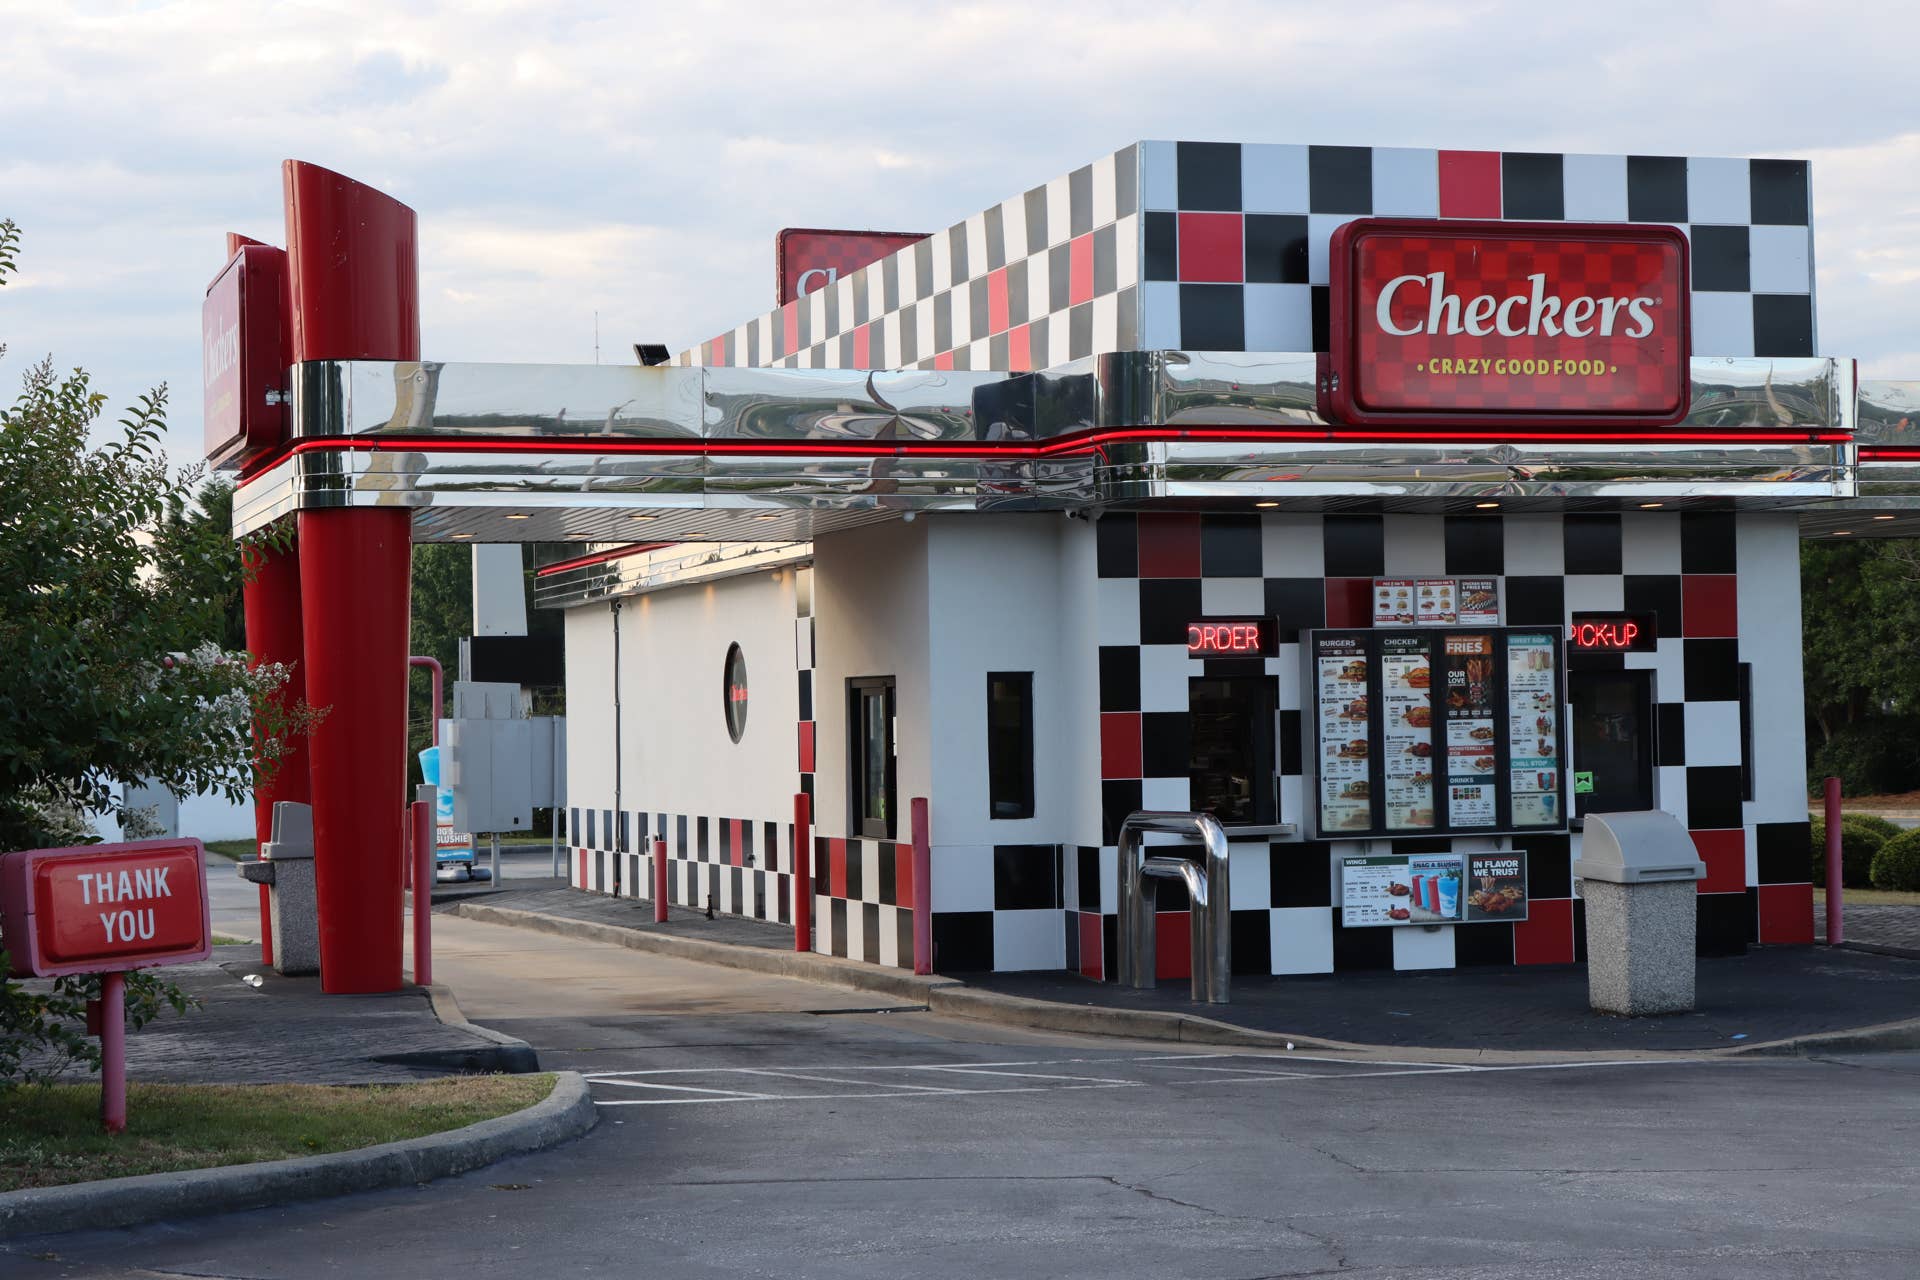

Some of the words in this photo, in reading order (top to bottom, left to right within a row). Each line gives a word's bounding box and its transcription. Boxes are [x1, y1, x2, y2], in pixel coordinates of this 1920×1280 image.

[1376, 271, 1656, 338] Checkers
[1429, 358, 1491, 375] CRAZY
[1495, 358, 1550, 376] GOOD
[1553, 359, 1606, 376] FOOD
[1446, 642, 1483, 653] FRIES
[1448, 670, 1465, 678] OUR
[436, 835, 468, 844] SLUSHIE
[1473, 860, 1482, 868] IN
[1485, 860, 1519, 868] FLAVOR
[1491, 868, 1519, 876] TRUST
[77, 866, 172, 905] THANK
[100, 908, 155, 943] YOU
